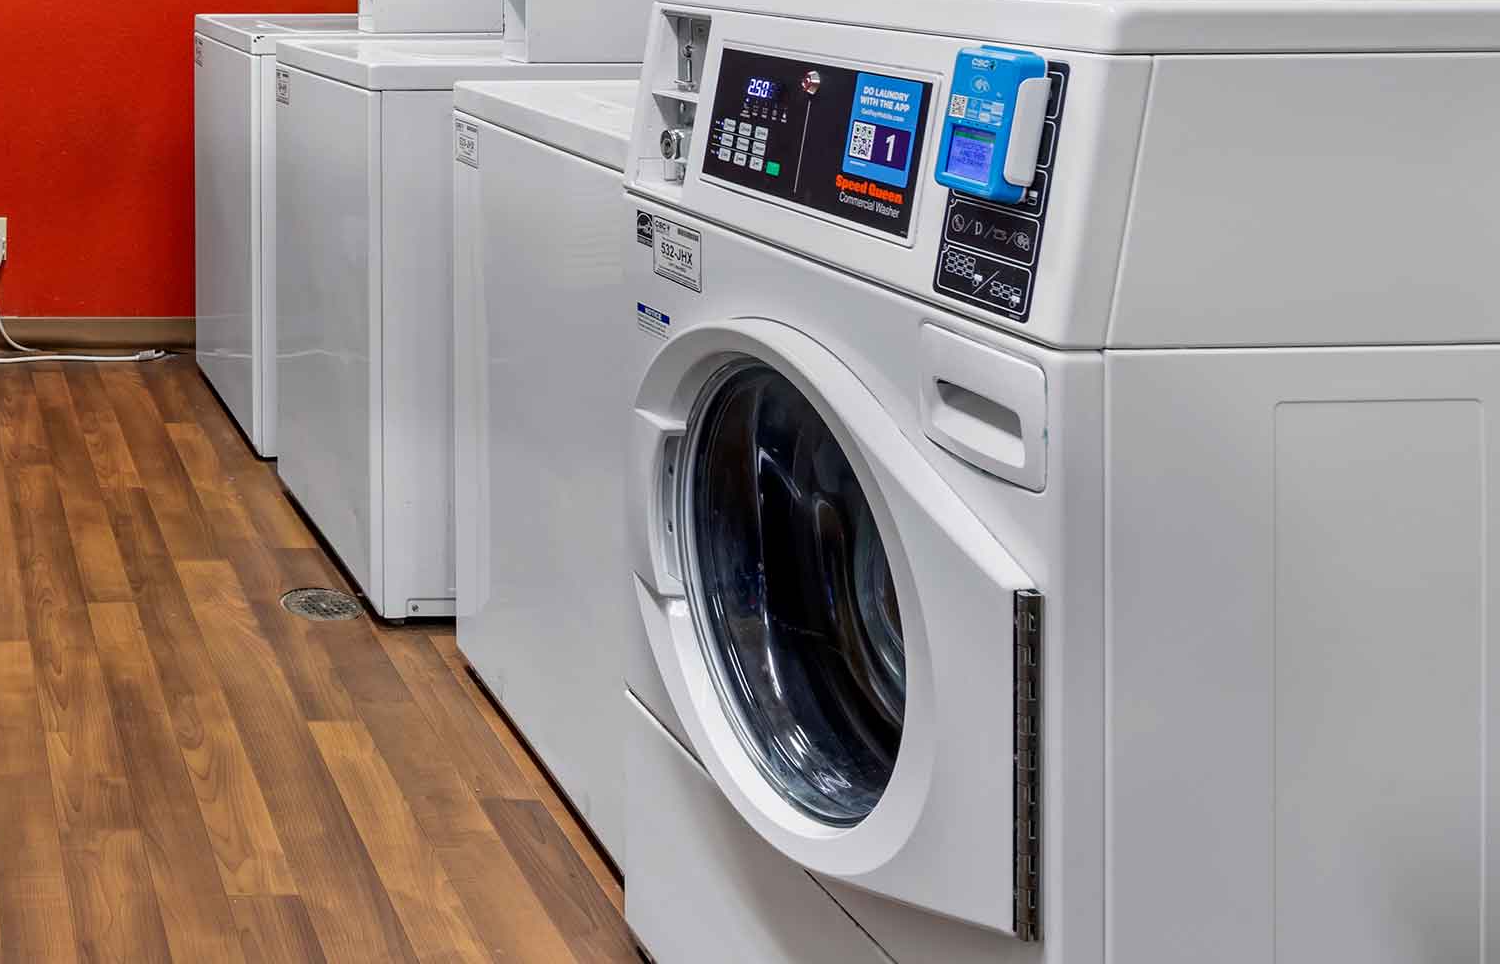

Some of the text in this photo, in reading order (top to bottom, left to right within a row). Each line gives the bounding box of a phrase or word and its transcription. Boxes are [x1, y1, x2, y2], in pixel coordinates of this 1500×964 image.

[860, 95, 910, 113] WITH THE APP
[863, 86, 910, 102] DO LAUNDRY
[885, 134, 896, 162] 1
[835, 174, 904, 205] Speed Queen
[838, 191, 900, 219] Commercial Washer
[660, 242, 693, 266] 532-JHX
